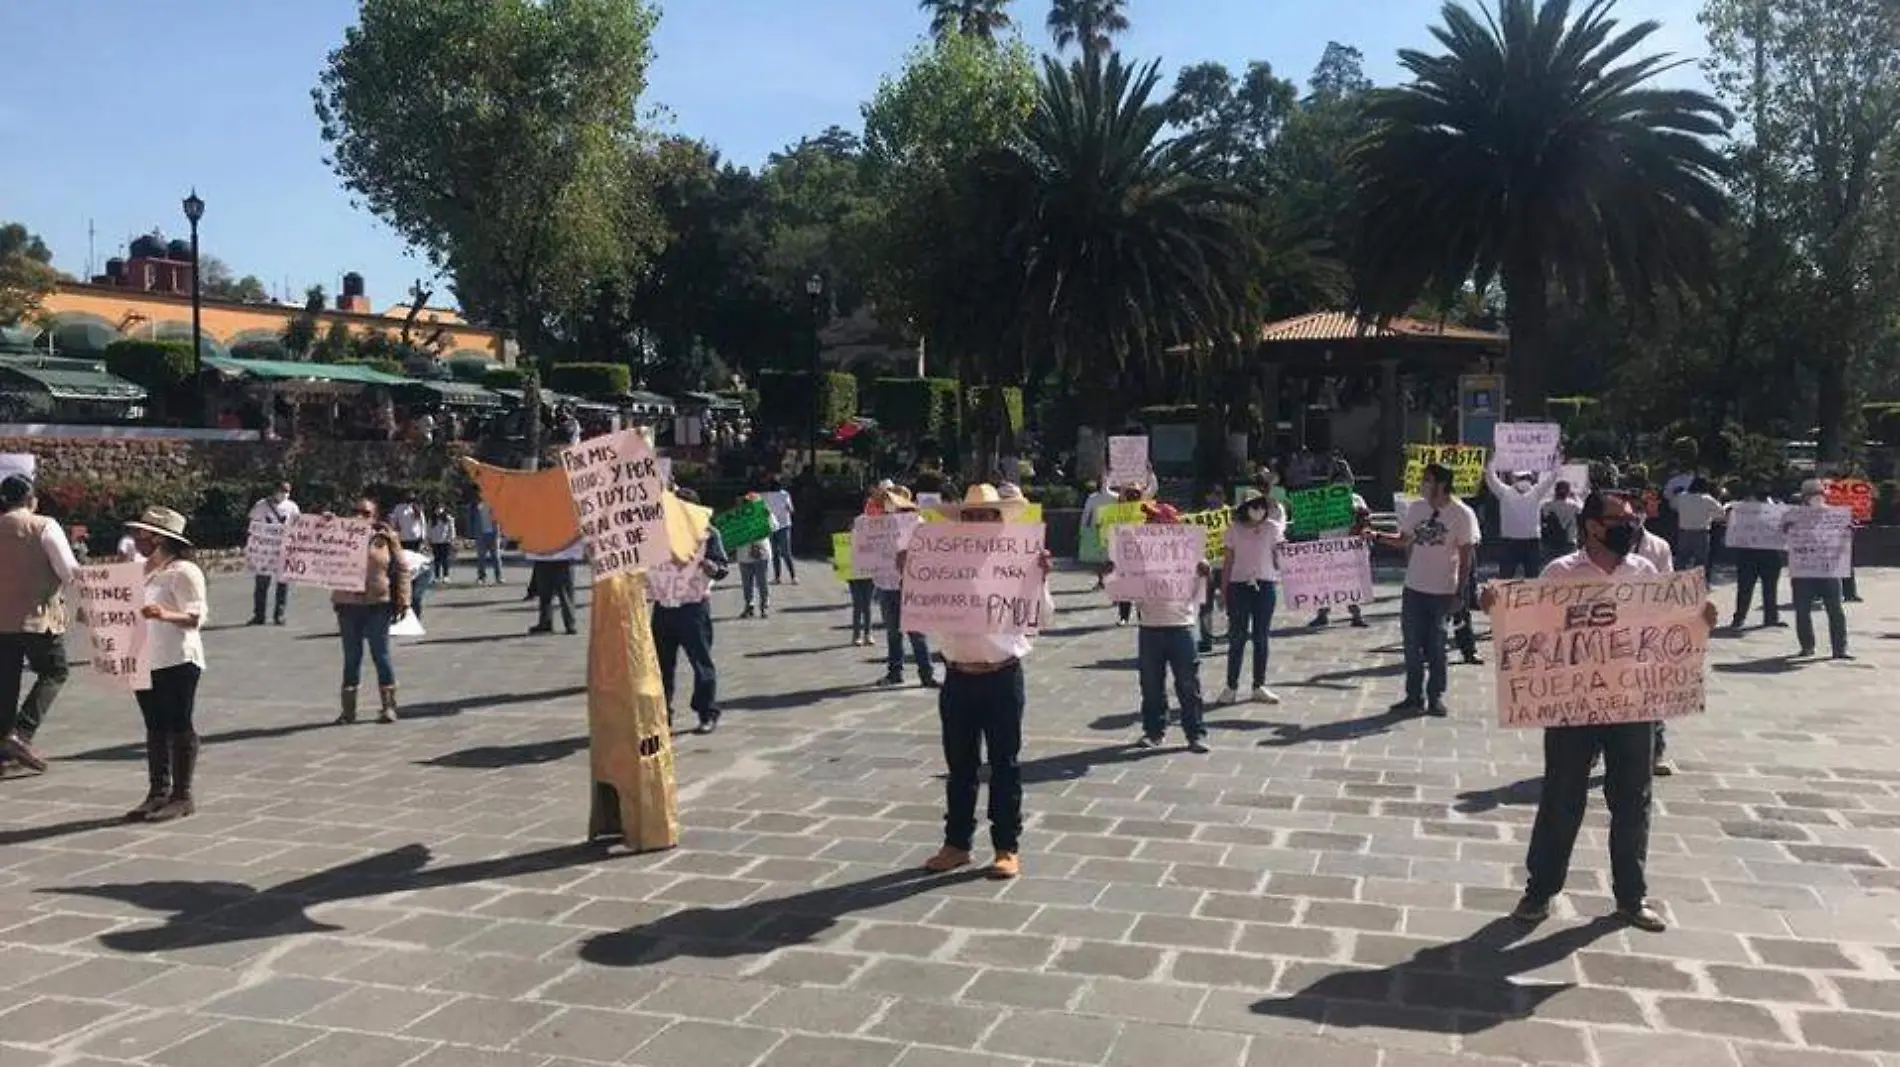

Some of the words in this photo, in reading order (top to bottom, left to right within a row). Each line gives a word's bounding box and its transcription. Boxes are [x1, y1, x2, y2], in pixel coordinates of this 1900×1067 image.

[588, 447, 618, 466] MIS
[610, 463, 622, 483] Y
[626, 457, 656, 480] POR
[596, 482, 648, 508] TUYOS
[283, 559, 307, 575] NO
[986, 592, 1040, 628] PMDU
[1294, 589, 1362, 609] PMDU
[1564, 598, 1618, 631] ES
[1508, 670, 1609, 702] FUERA
